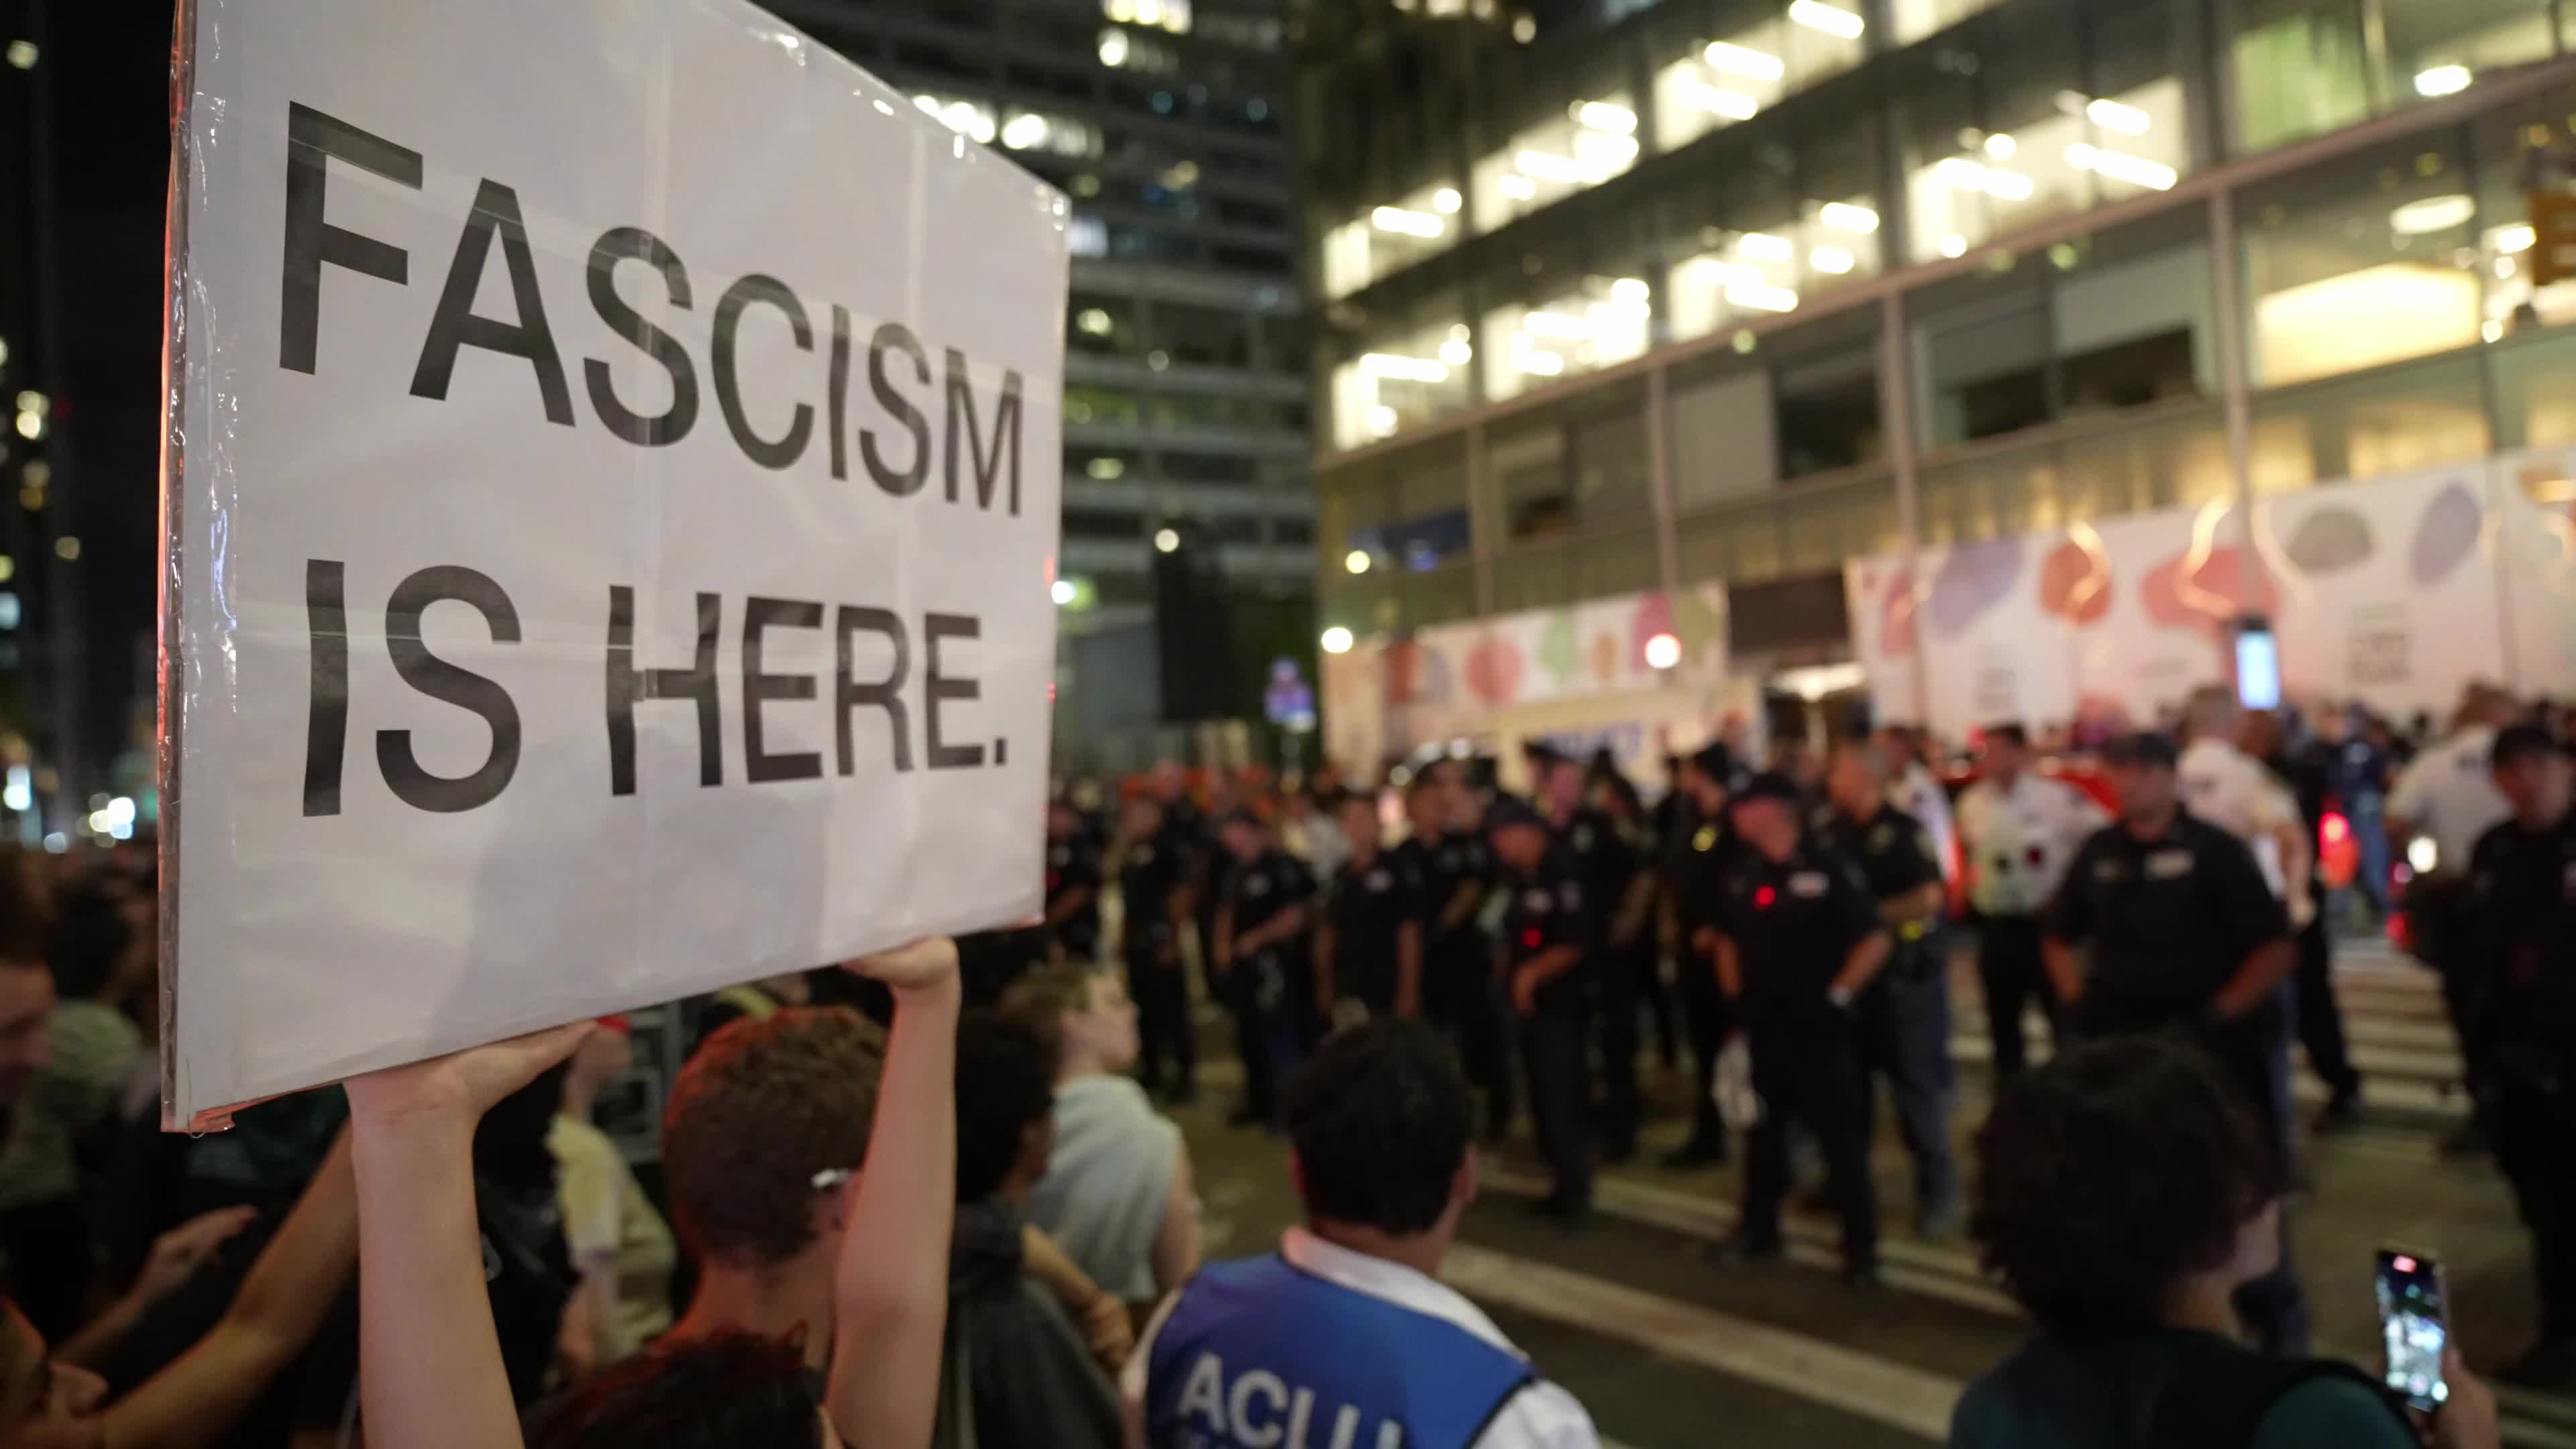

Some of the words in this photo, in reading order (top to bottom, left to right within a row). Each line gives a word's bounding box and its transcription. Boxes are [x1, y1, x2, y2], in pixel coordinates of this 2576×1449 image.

[279, 100, 1023, 517] FASCISM
[303, 558, 522, 817] IS
[606, 584, 1008, 796] HERE.
